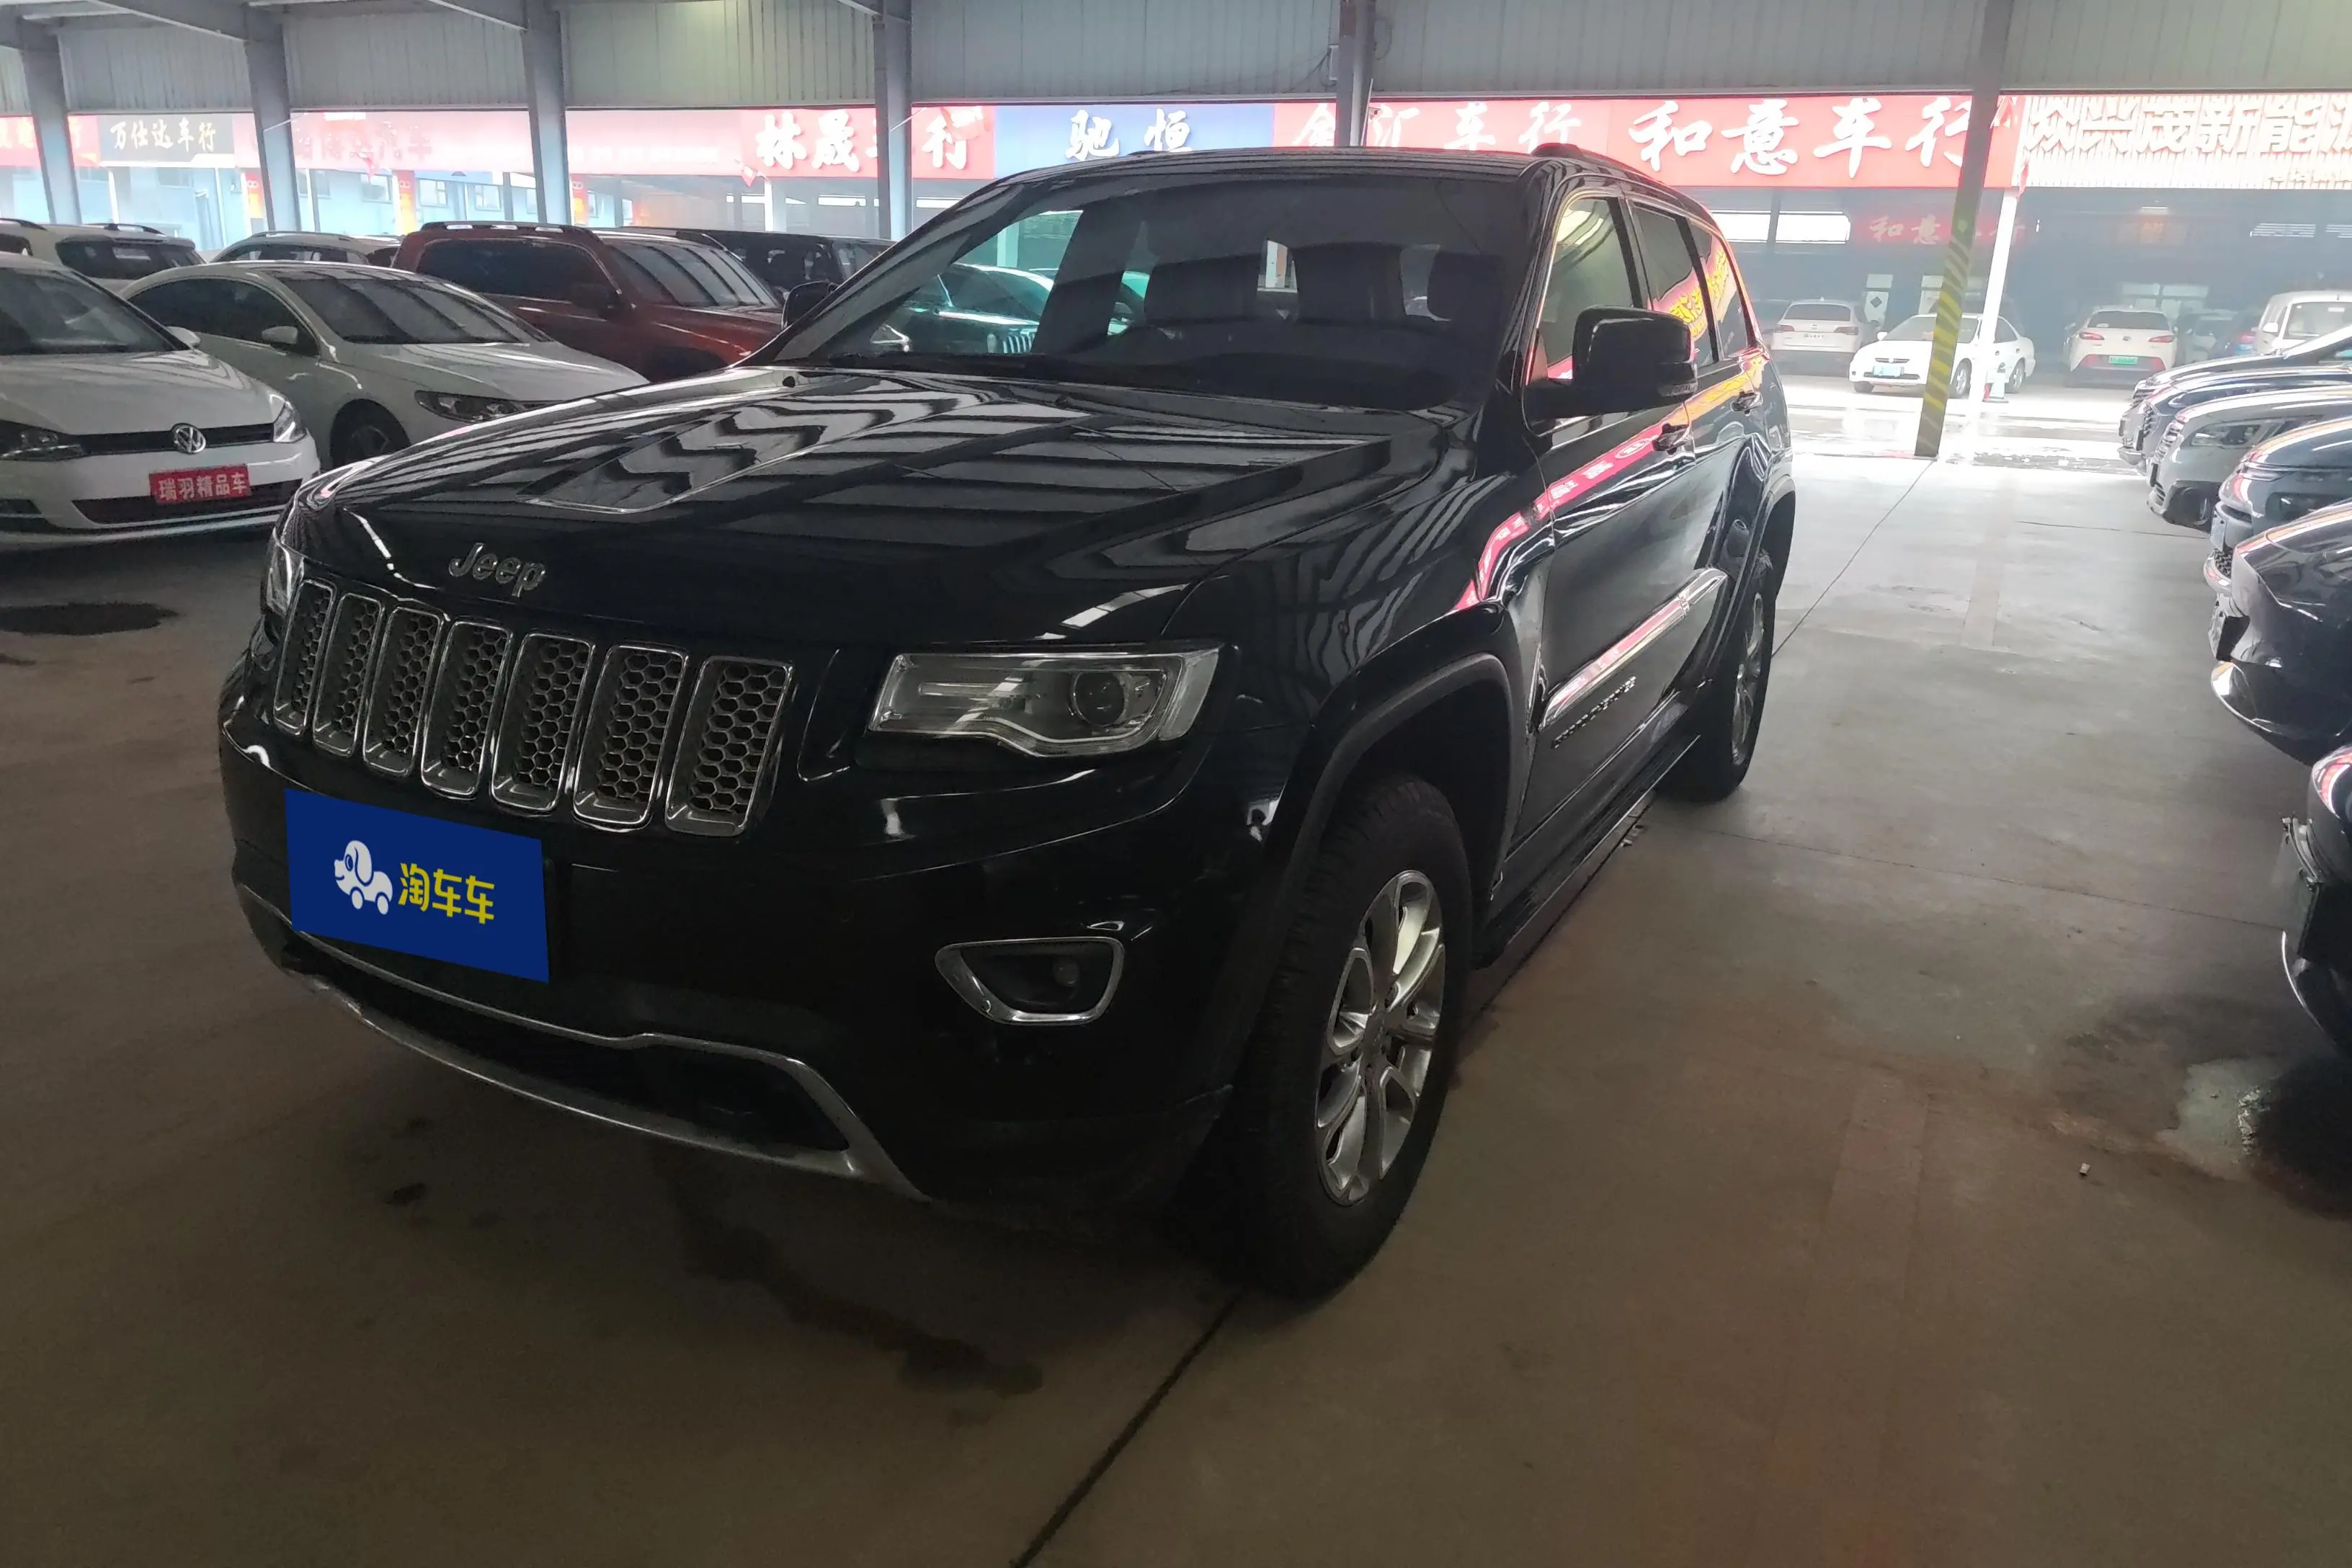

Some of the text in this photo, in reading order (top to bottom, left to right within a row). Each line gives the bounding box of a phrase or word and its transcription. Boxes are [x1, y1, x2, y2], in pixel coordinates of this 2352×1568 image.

[110, 116, 216, 153] 万仕达车行
[755, 109, 968, 173] 林晟行
[1064, 107, 1193, 161] 驰恒
[1628, 97, 1972, 179] 和意车行
[158, 471, 248, 502] 瑞羽精品车
[448, 542, 547, 598] Jeep
